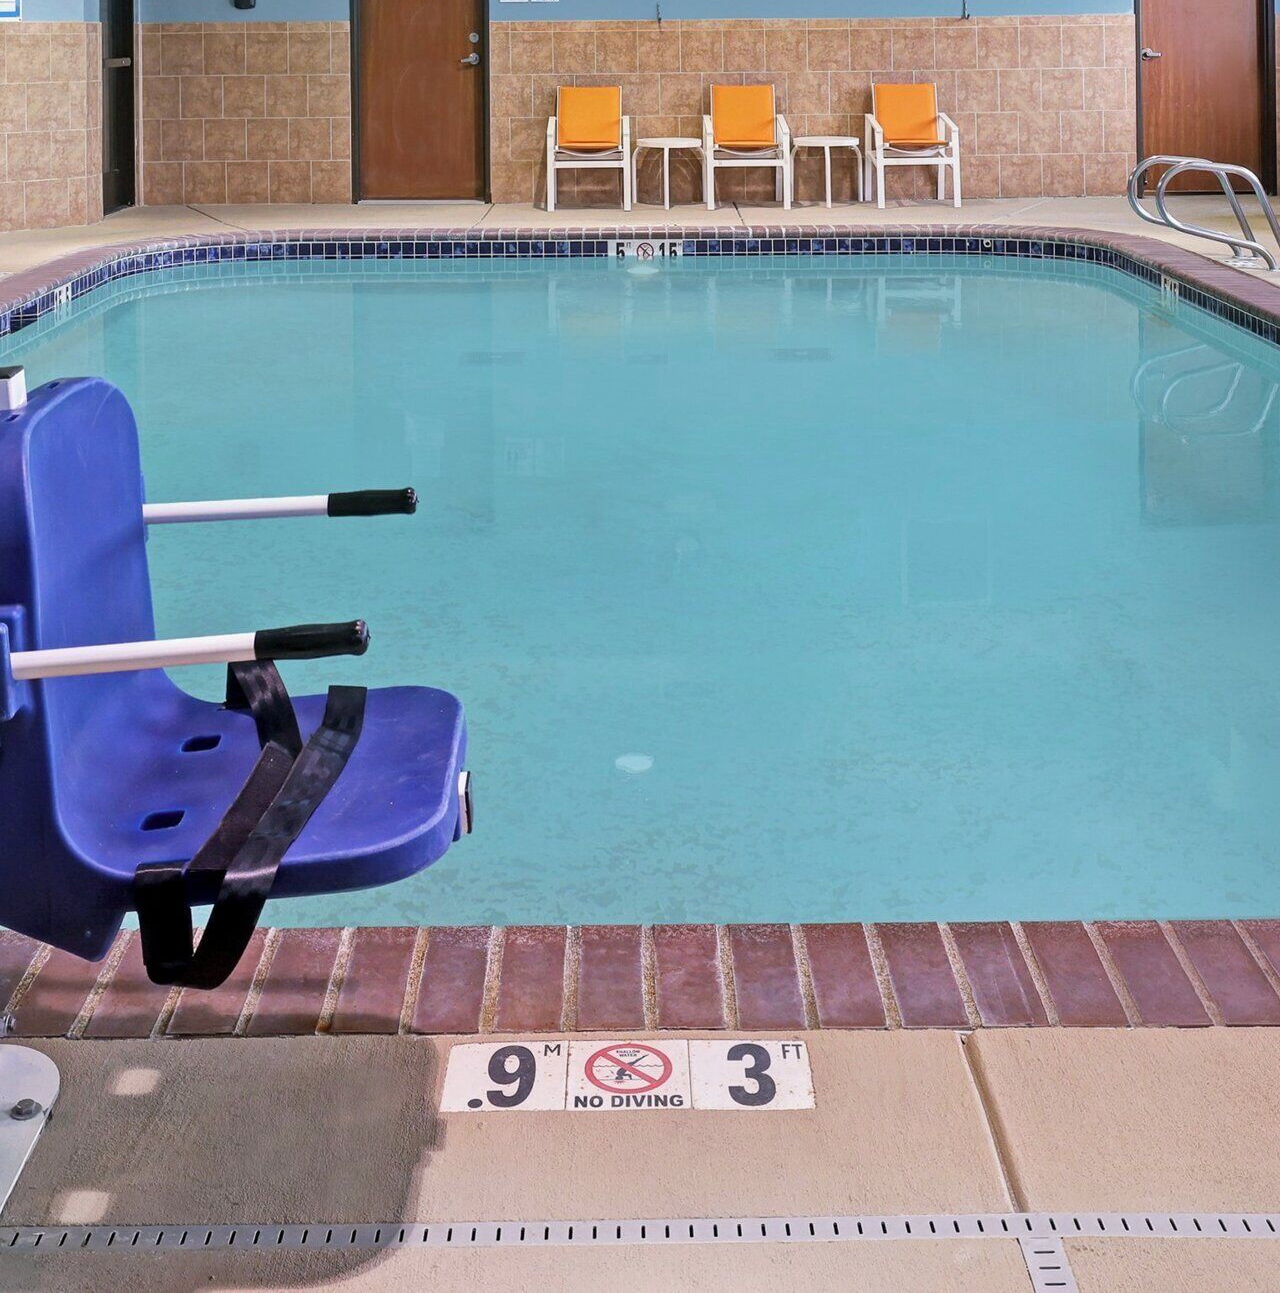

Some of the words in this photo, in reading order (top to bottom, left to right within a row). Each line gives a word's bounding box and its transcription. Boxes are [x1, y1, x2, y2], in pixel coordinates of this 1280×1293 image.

[467, 1044, 537, 1108] .9
[543, 1044, 561, 1057] M
[574, 1095, 604, 1109] NO
[611, 1094, 684, 1108] DIVING
[727, 1043, 777, 1106] 3
[781, 1044, 803, 1060] FT
